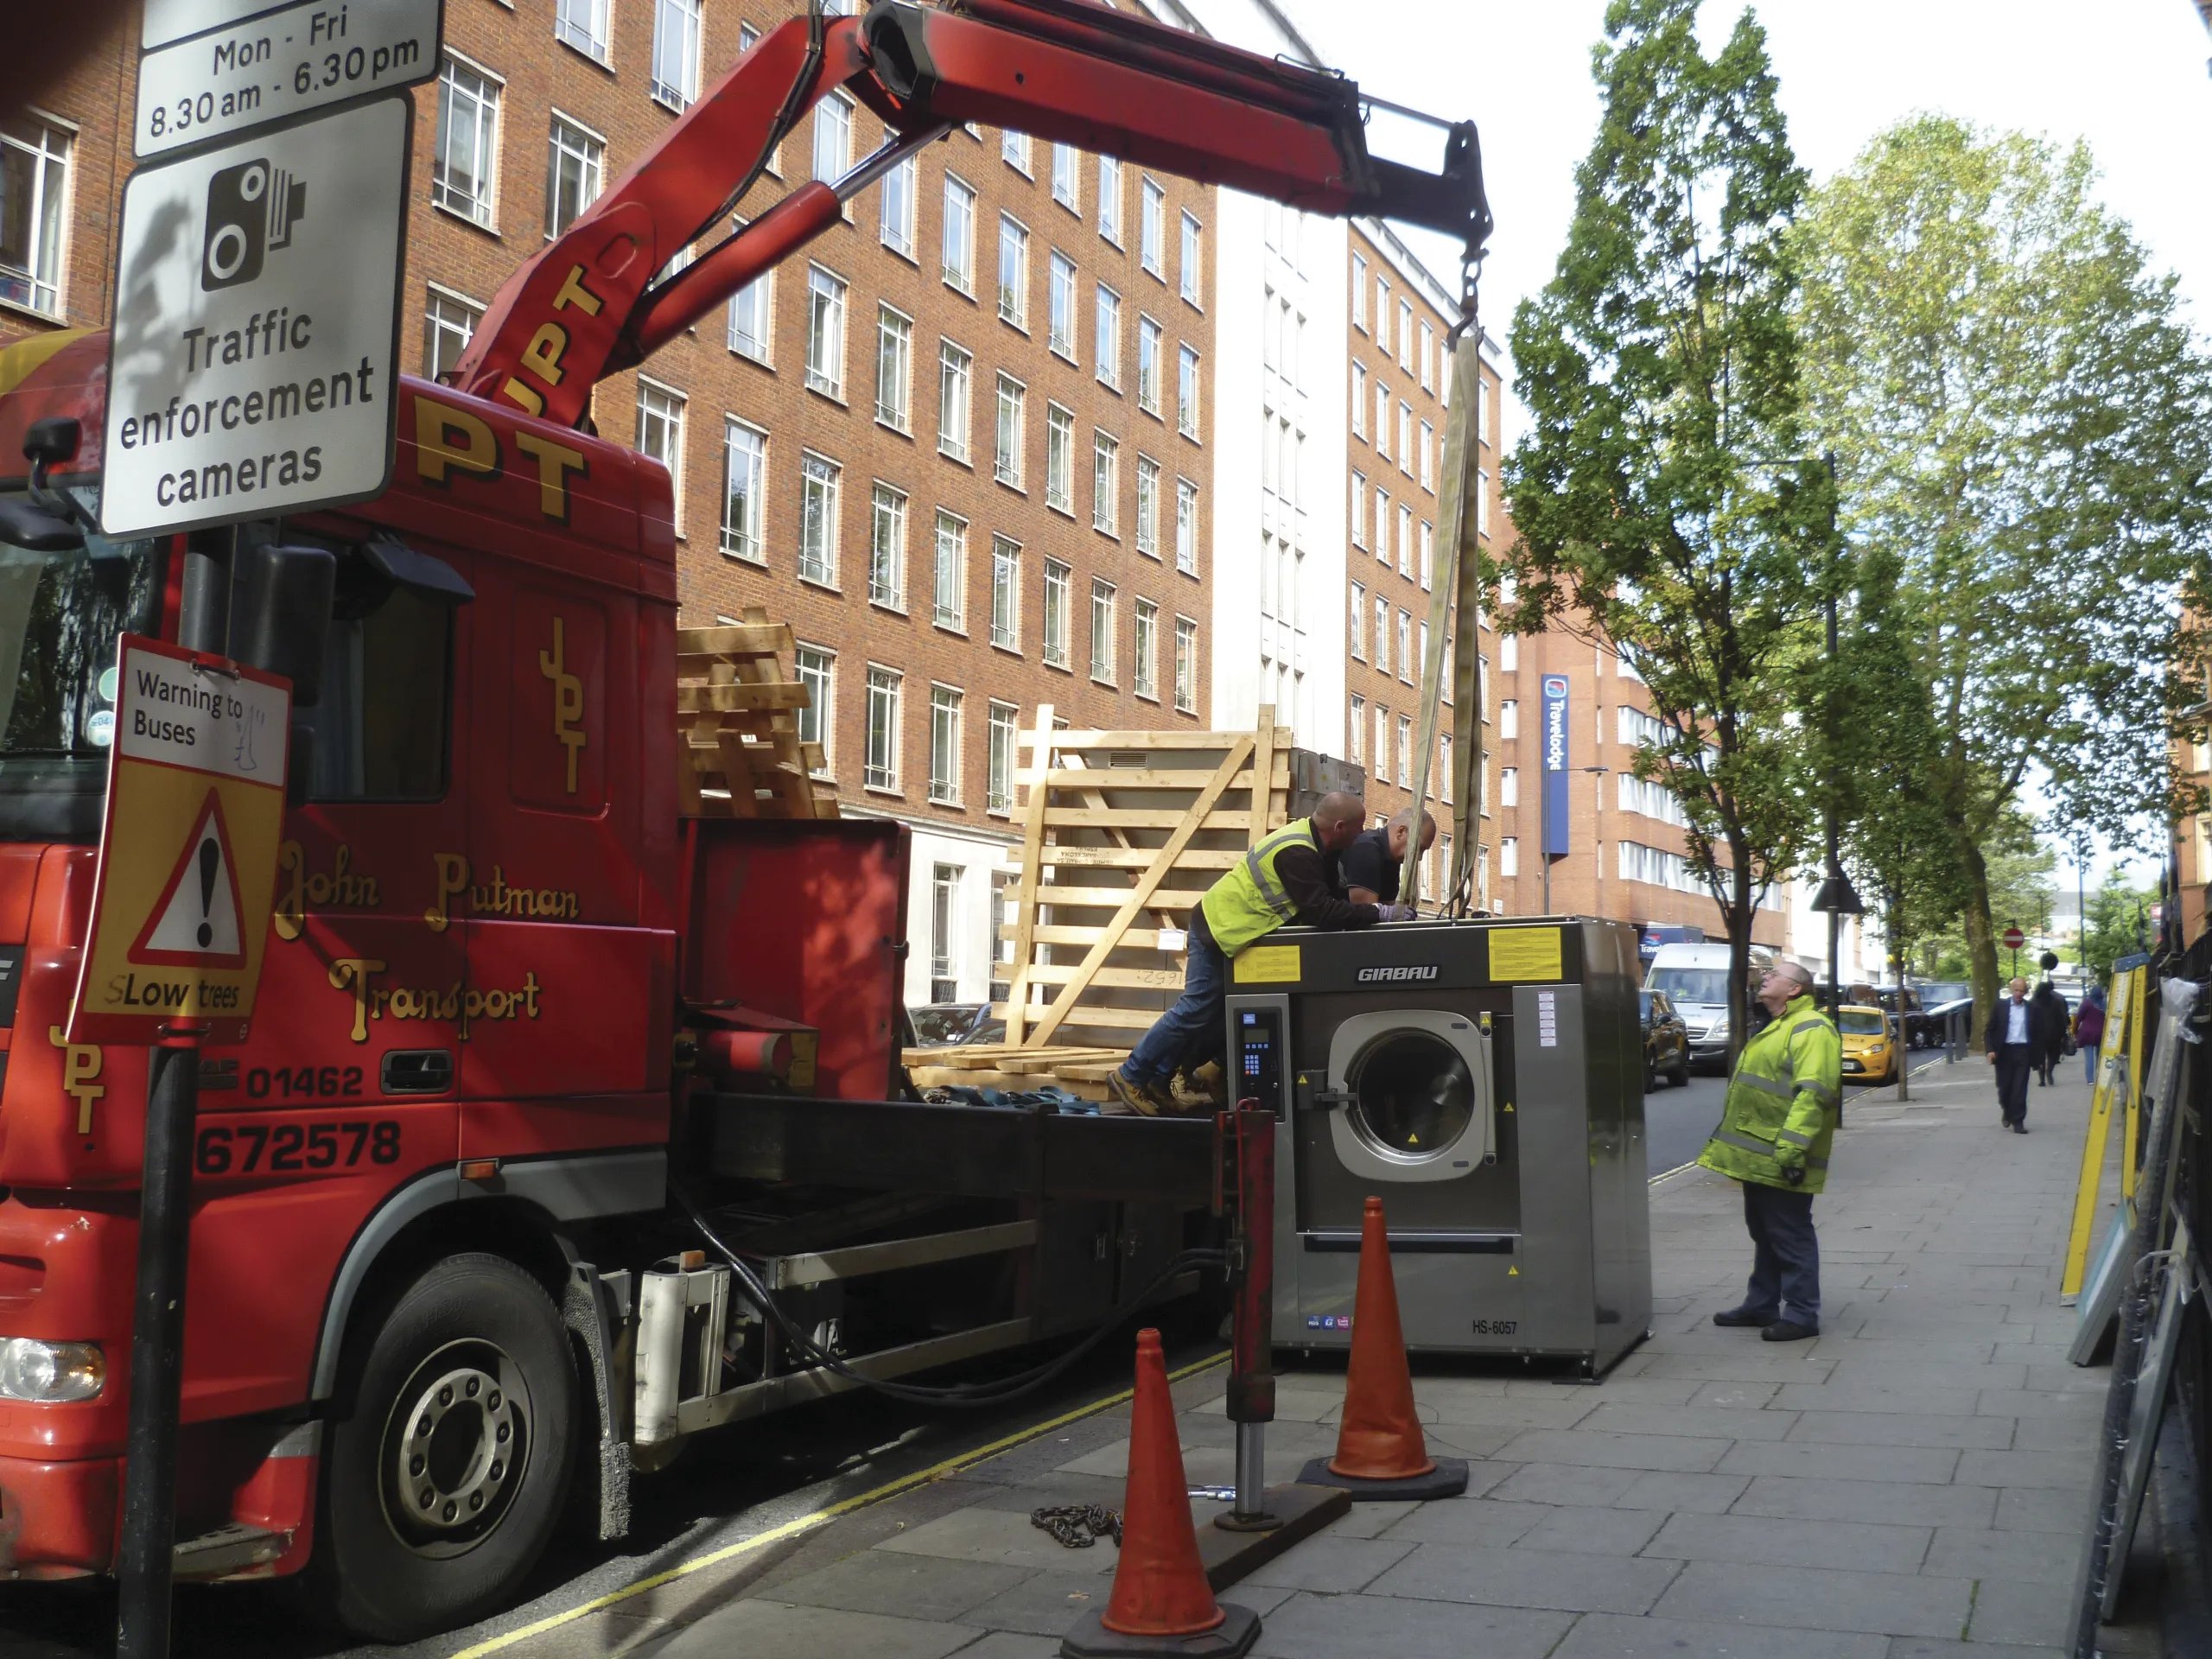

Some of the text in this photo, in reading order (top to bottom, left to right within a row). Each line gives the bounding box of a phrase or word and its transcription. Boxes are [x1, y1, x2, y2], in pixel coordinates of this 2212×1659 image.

[213, 37, 271, 76] Mon
[310, 5, 348, 46] Fri
[183, 307, 313, 372] Traffic
[121, 357, 374, 449] enforcement
[156, 445, 322, 507] cameras
[137, 669, 243, 720] Warning to
[539, 616, 587, 793] JPT
[134, 709, 196, 747] Buses
[1547, 699, 1565, 771] Travelodge
[274, 839, 580, 940] John Putman
[197, 979, 240, 1009] trees
[328, 958, 541, 1042] Transport
[1357, 966, 1438, 982] GIRBAU
[246, 1066, 363, 1098] 01462
[196, 1120, 401, 1174] 672578
[1472, 1319, 1517, 1335] HS-6057
